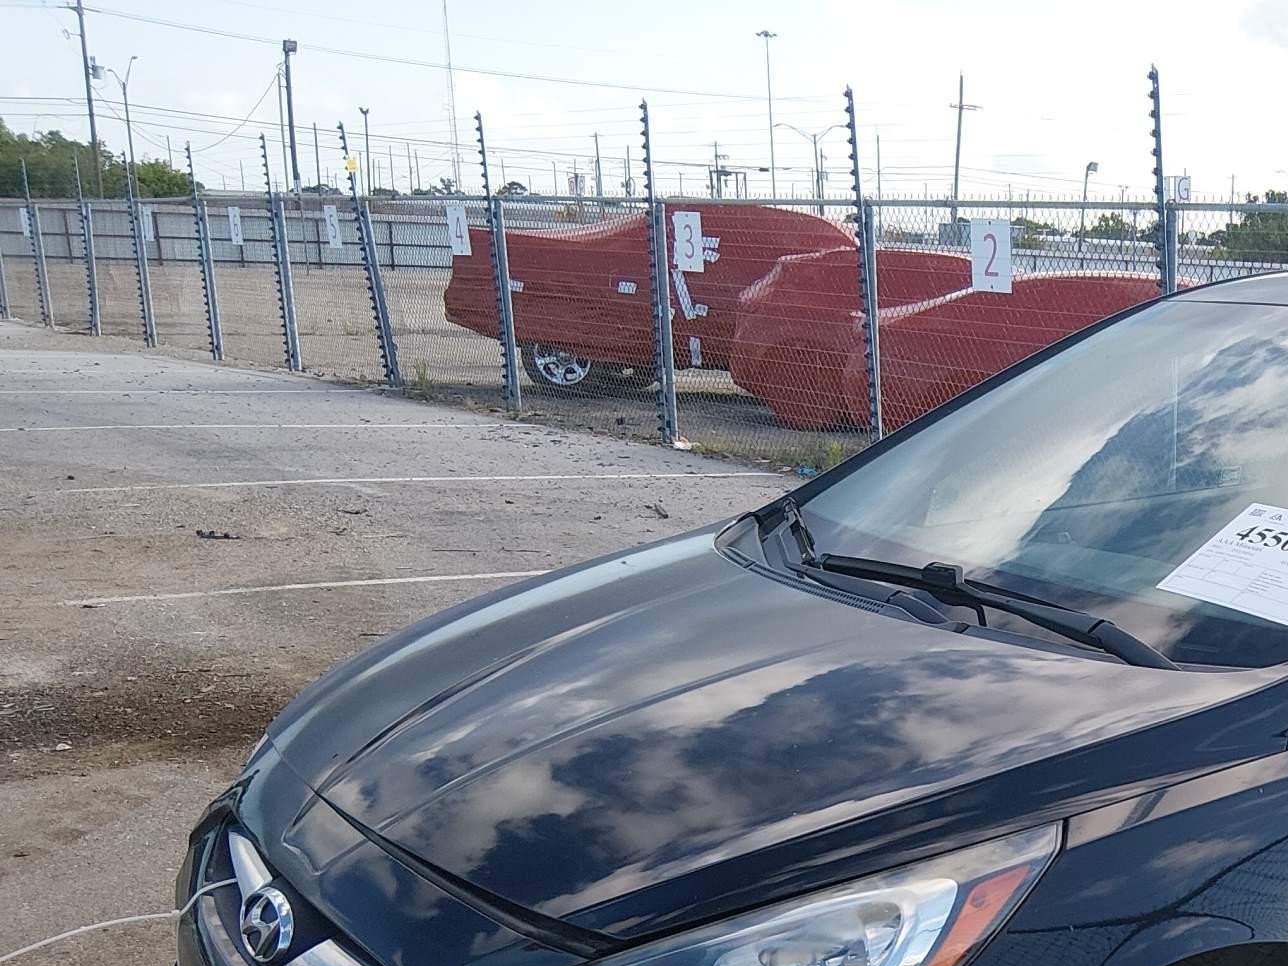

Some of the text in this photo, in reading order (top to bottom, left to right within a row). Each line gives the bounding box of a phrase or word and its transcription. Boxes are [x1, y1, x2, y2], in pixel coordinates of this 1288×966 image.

[1177, 177, 1191, 201] G
[233, 214, 240, 237] 6
[329, 214, 338, 239] 5
[455, 216, 464, 245] 4
[683, 223, 696, 259] 3
[983, 233, 999, 277] 2
